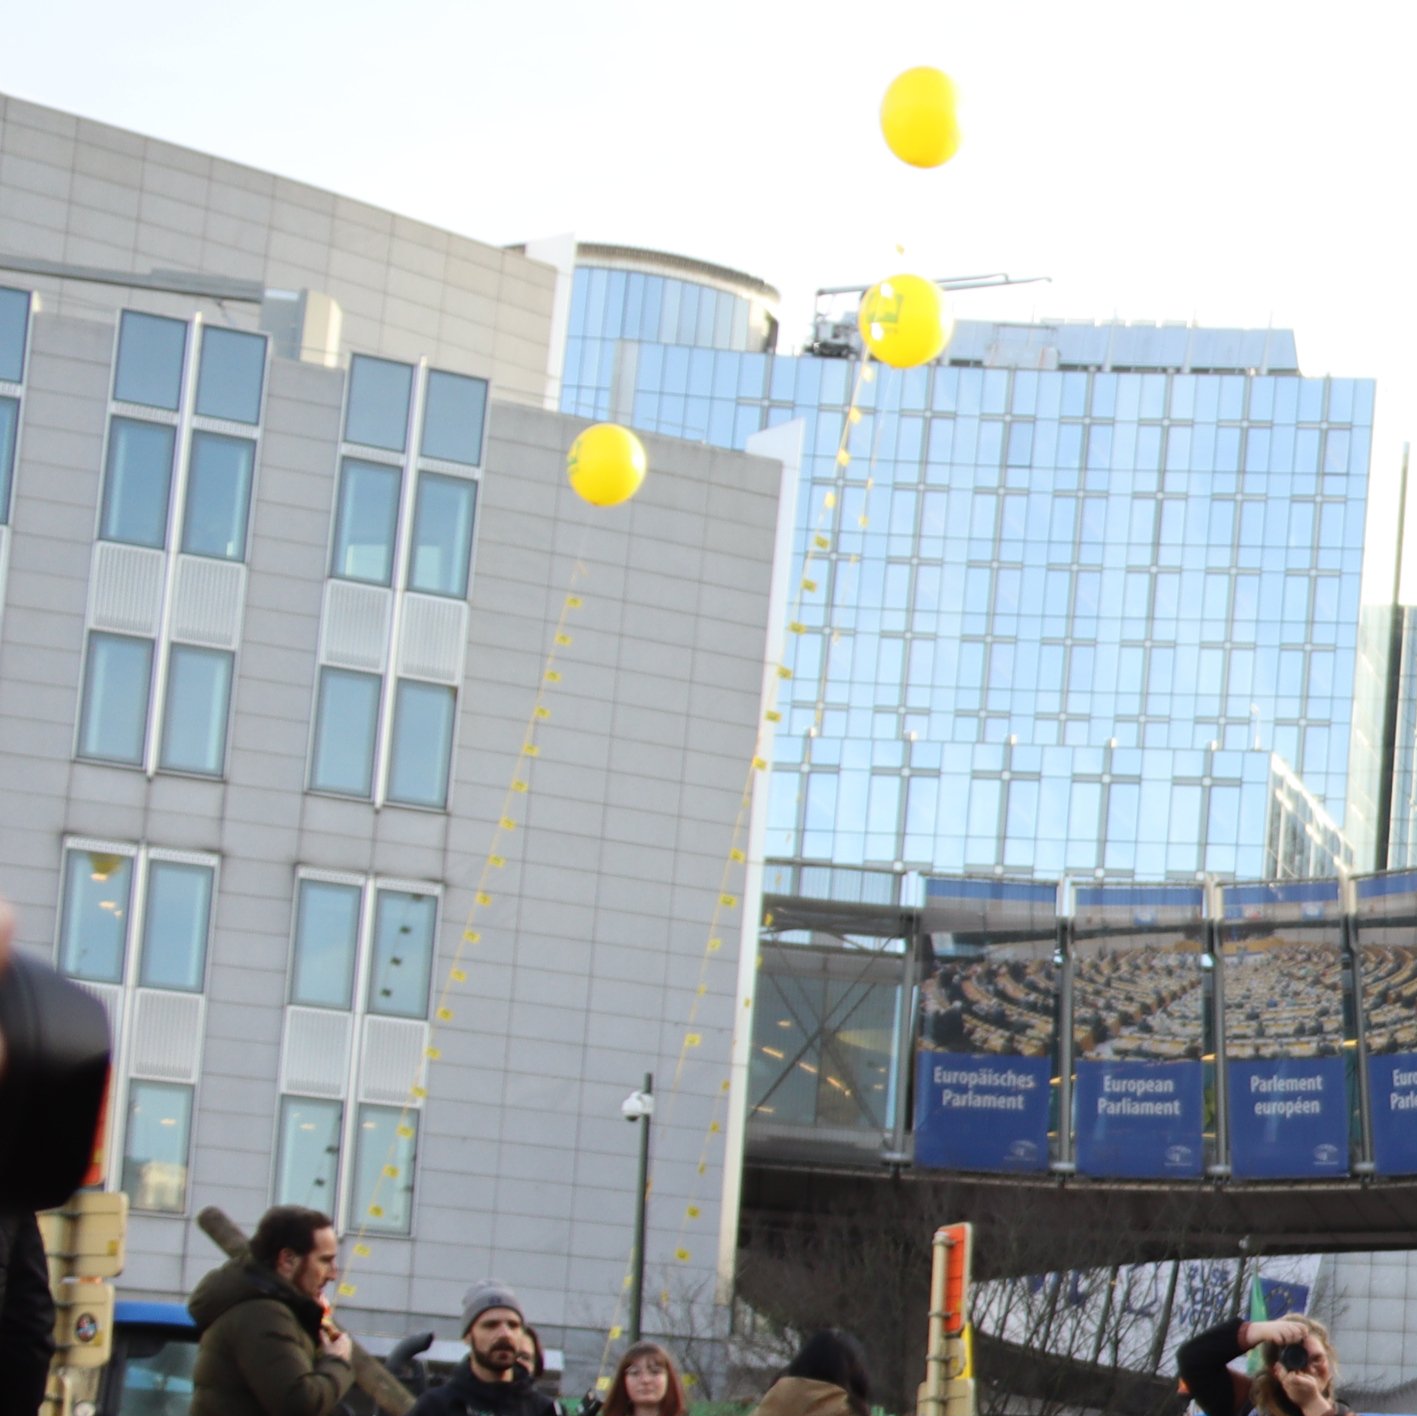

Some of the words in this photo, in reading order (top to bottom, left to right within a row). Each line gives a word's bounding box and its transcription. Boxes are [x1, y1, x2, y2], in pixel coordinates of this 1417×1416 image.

[933, 1066, 1037, 1089] Europäisches
[1103, 1075, 1175, 1096] European
[1250, 1074, 1323, 1093] Parlement
[942, 1089, 1025, 1110] Parlament
[1097, 1098, 1181, 1116] Parliament
[1254, 1096, 1321, 1118] européen
